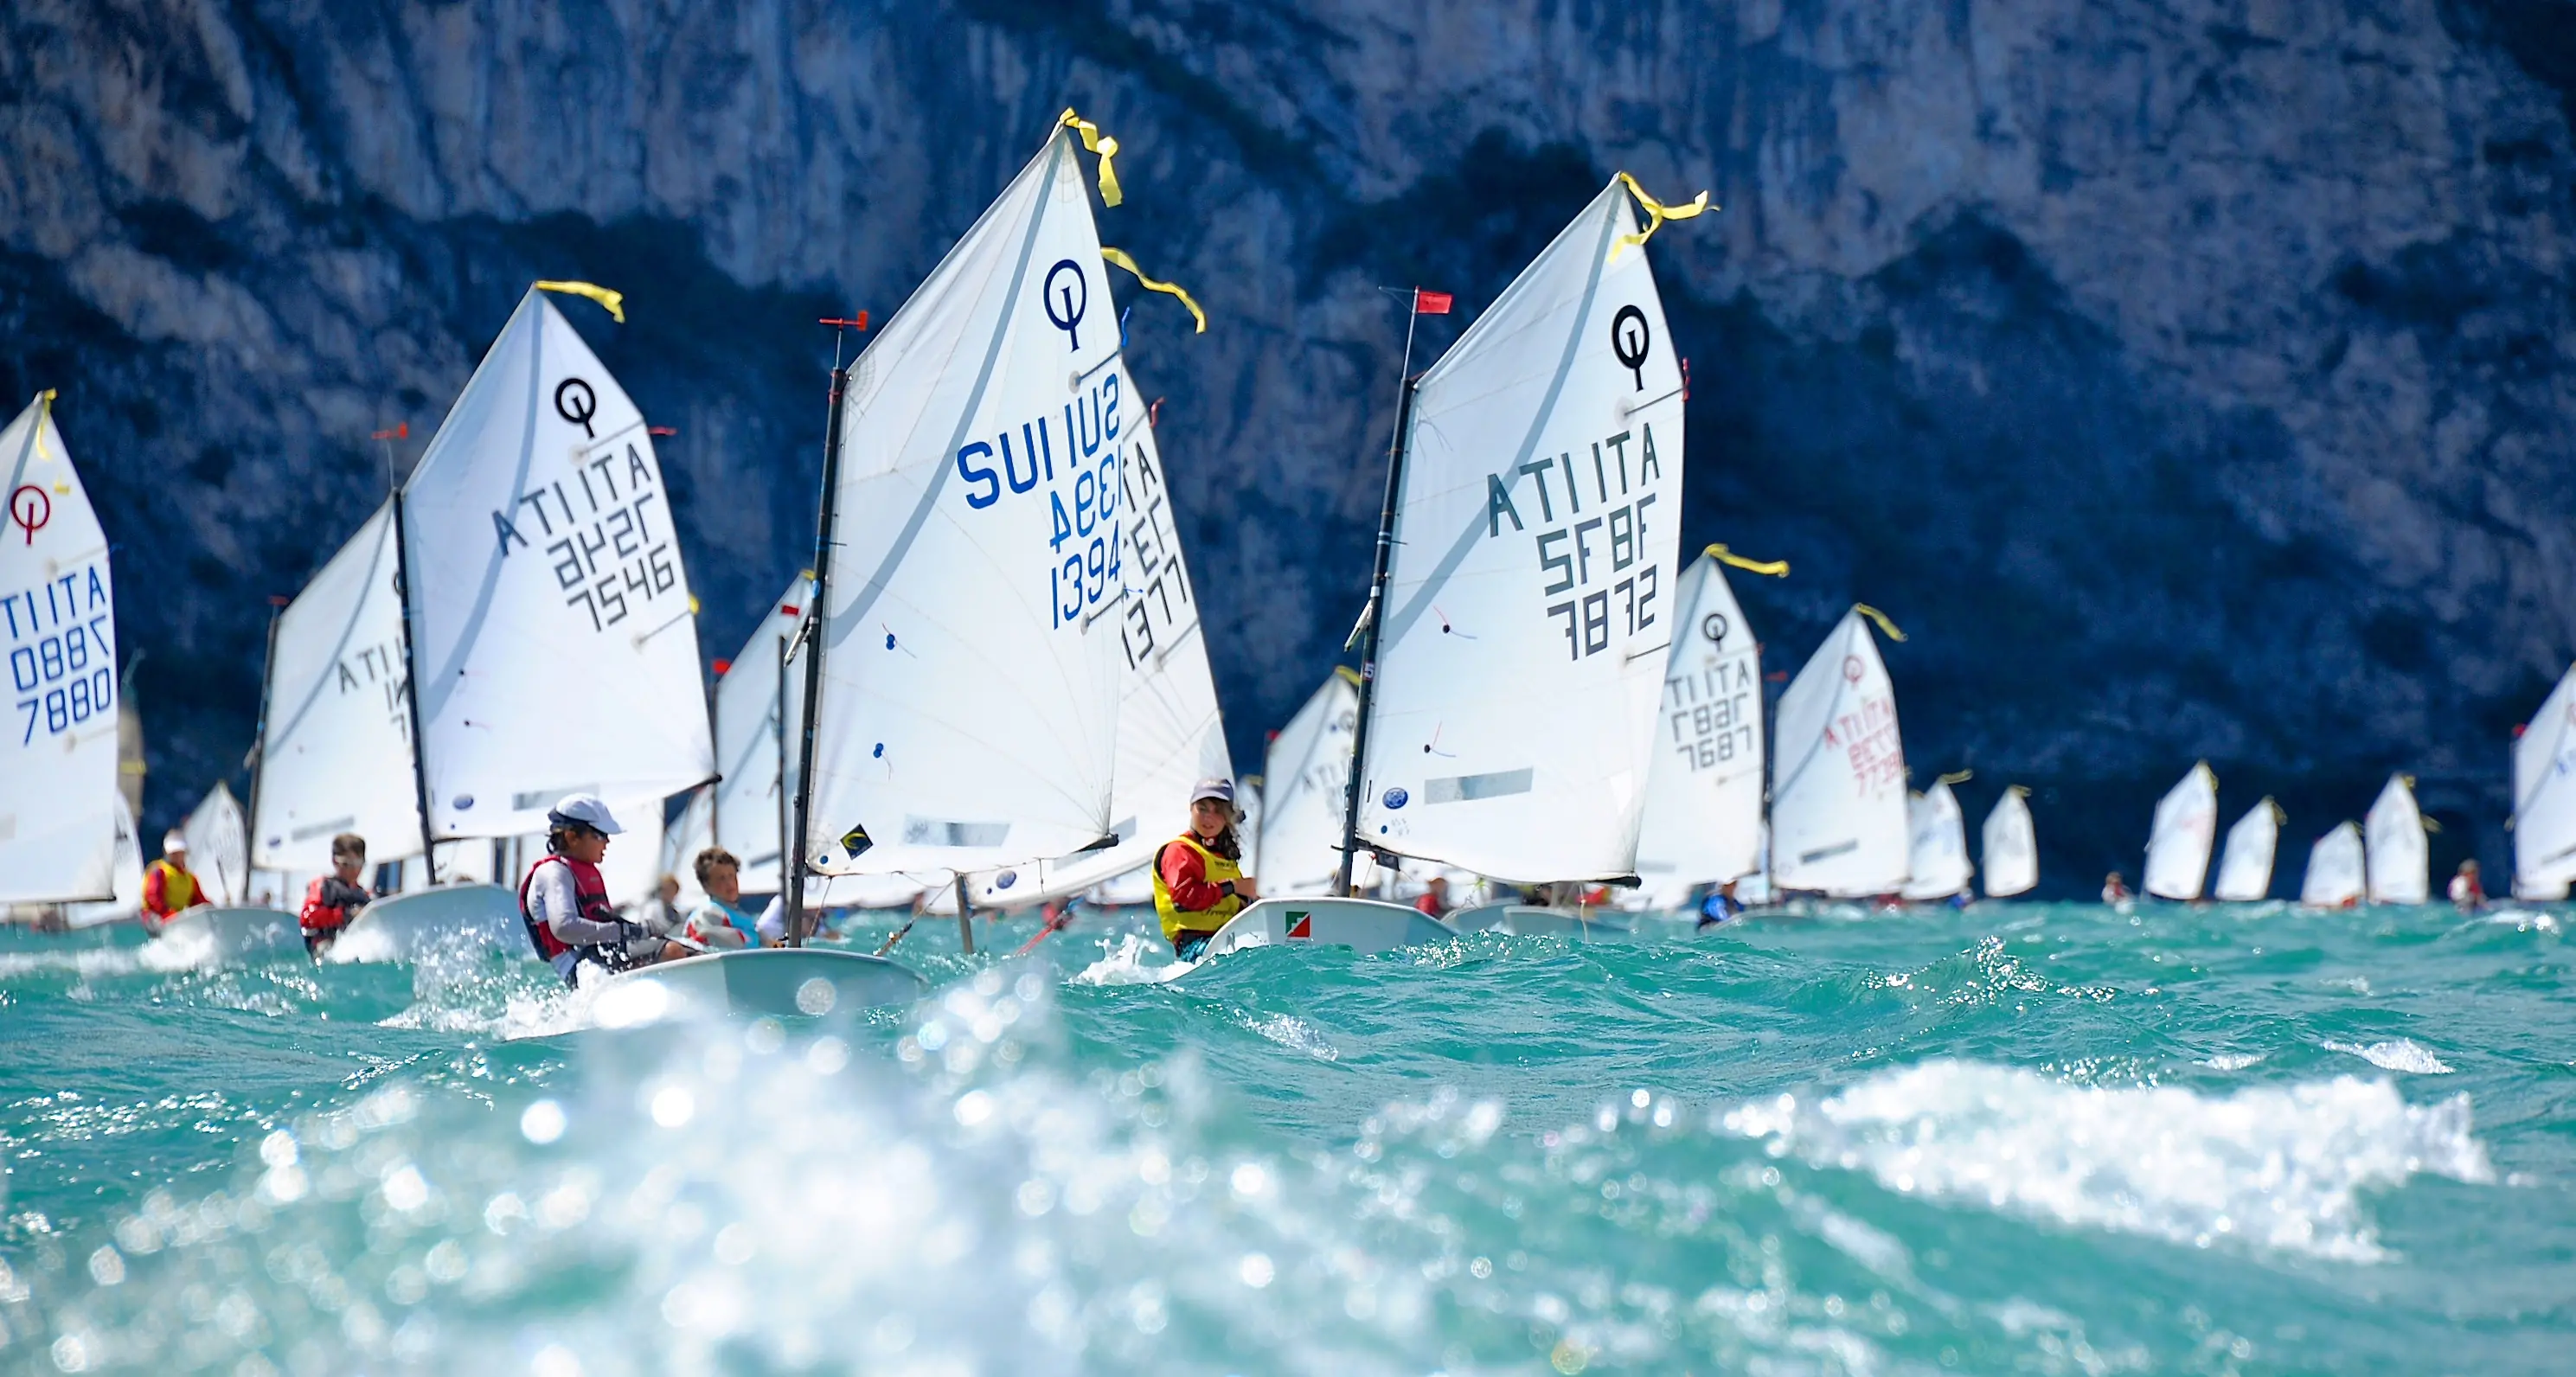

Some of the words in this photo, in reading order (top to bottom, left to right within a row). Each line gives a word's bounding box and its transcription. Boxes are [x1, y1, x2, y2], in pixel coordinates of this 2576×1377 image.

[577, 442, 652, 514] ITA
[957, 416, 1054, 509] SUI
[1590, 421, 1660, 504] ITA
[47, 566, 106, 625] ITA
[567, 543, 676, 633] 7546
[1050, 519, 1122, 630] 1394
[1547, 563, 1657, 662] 7872
[16, 667, 112, 746] 7880
[1704, 658, 1751, 698] ITA
[1676, 724, 1751, 772] 7687
